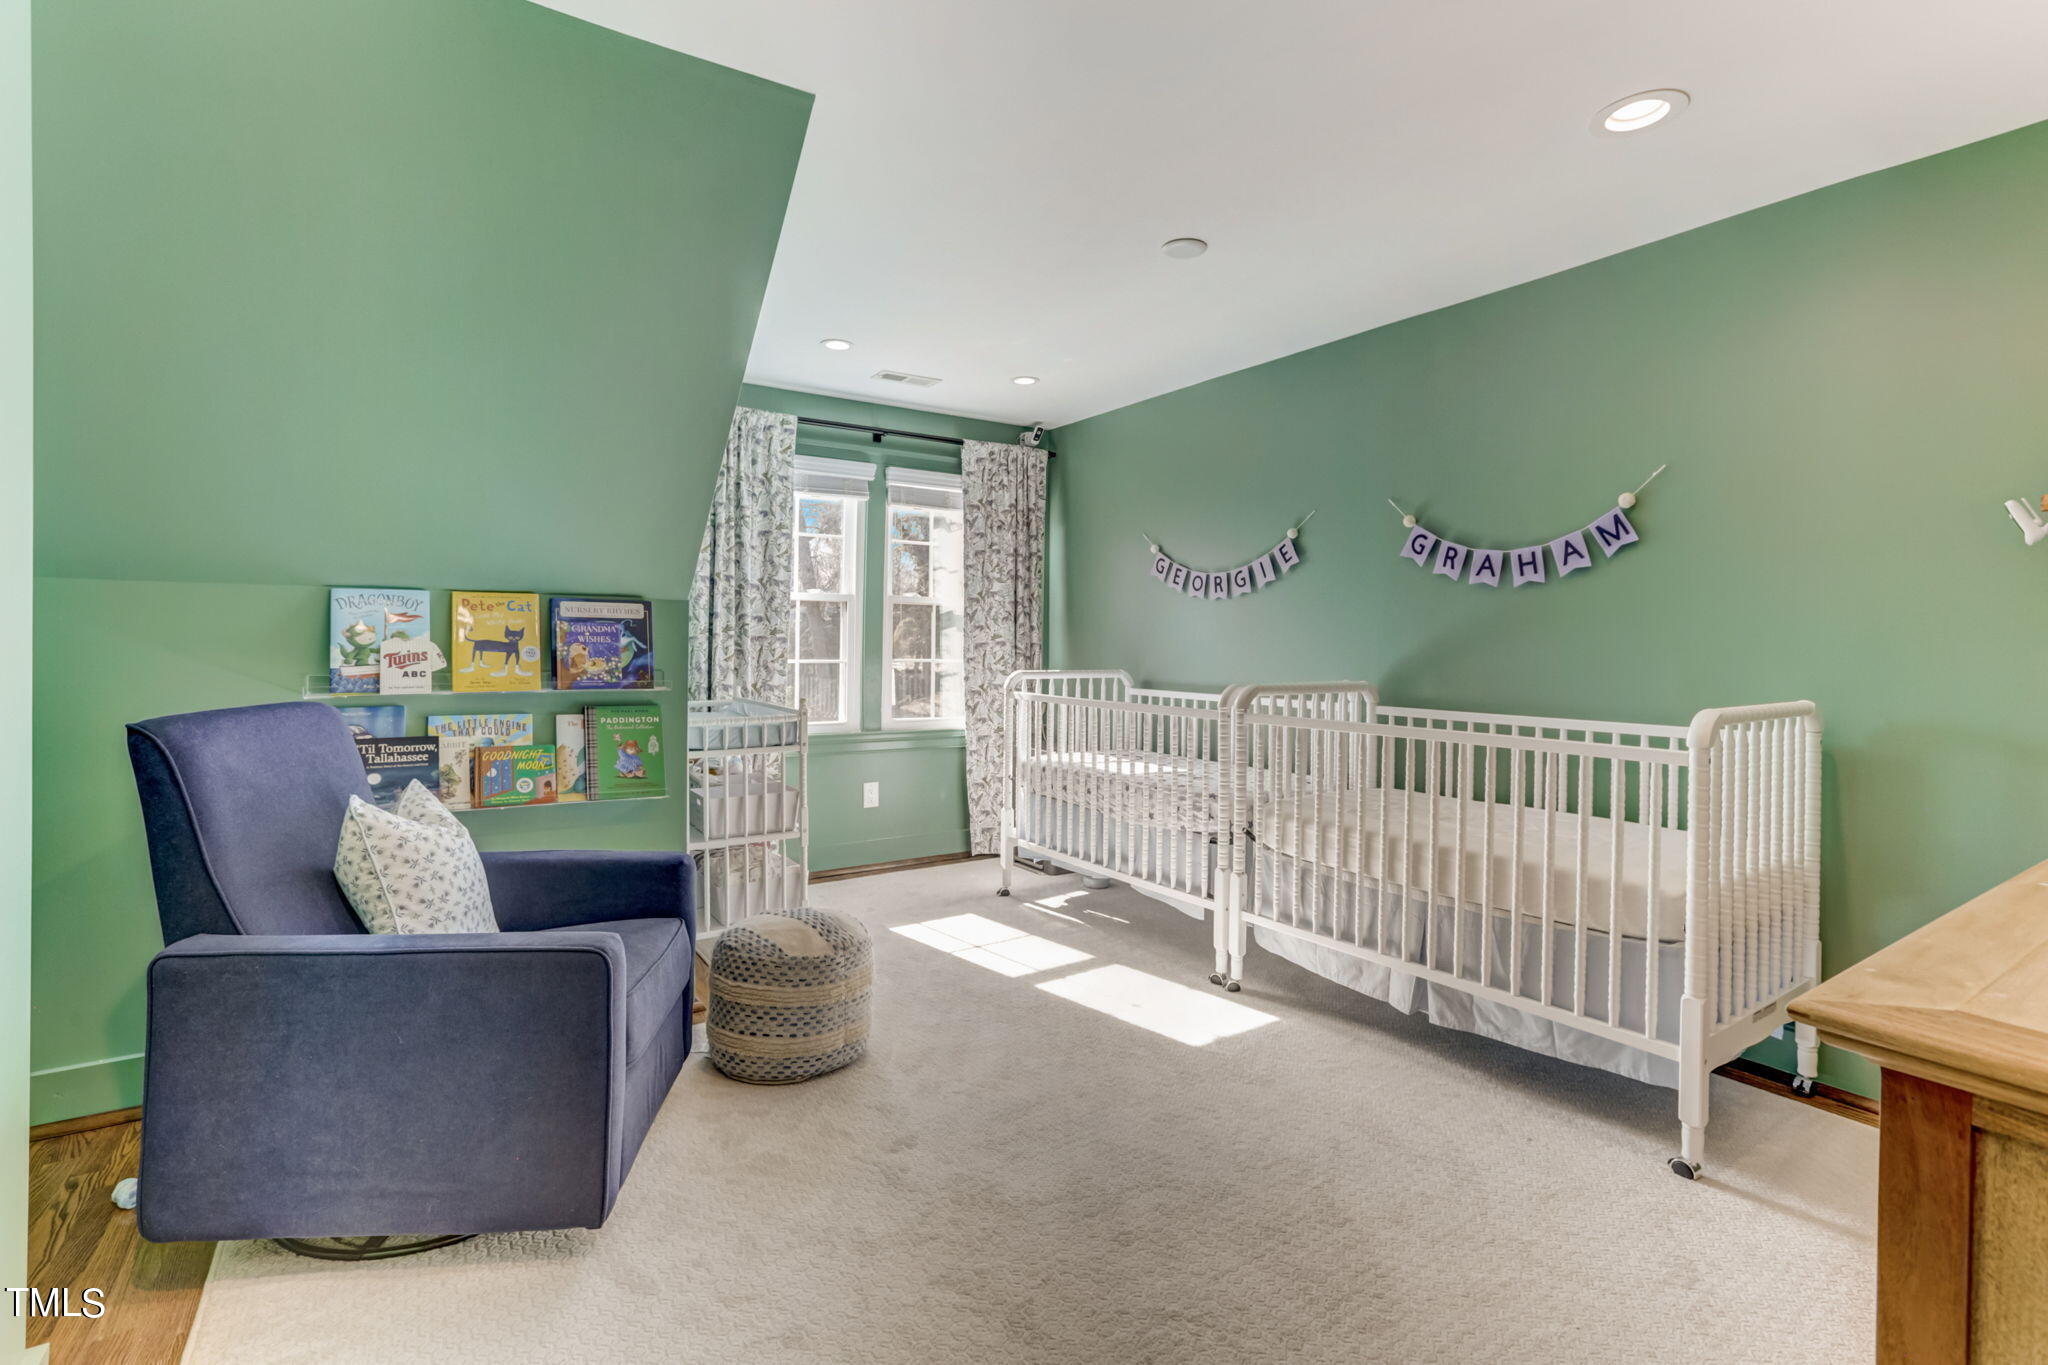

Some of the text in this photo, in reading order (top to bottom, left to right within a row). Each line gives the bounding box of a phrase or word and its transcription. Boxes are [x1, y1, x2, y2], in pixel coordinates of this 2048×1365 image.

[1411, 513, 1630, 577] GRAHAM
[1155, 543, 1293, 593] GEORGIE
[335, 592, 424, 611] DRAGONBOY
[461, 598, 494, 611] Pete
[507, 600, 532, 612] Cat
[565, 606, 641, 615] NURSERY RHYMES
[571, 624, 616, 633] GRANDMA
[577, 633, 611, 643] WISHES
[383, 650, 428, 669] Twins
[600, 716, 660, 724] PADDINGTON
[434, 718, 527, 734] THE LITTLE ENGINE
[452, 726, 511, 736] THAT COULD
[378, 743, 438, 754] Tomorrow,
[366, 753, 429, 764] Tallahassee
[482, 748, 544, 761] GOODNIGHT
[516, 760, 547, 770] MOON
